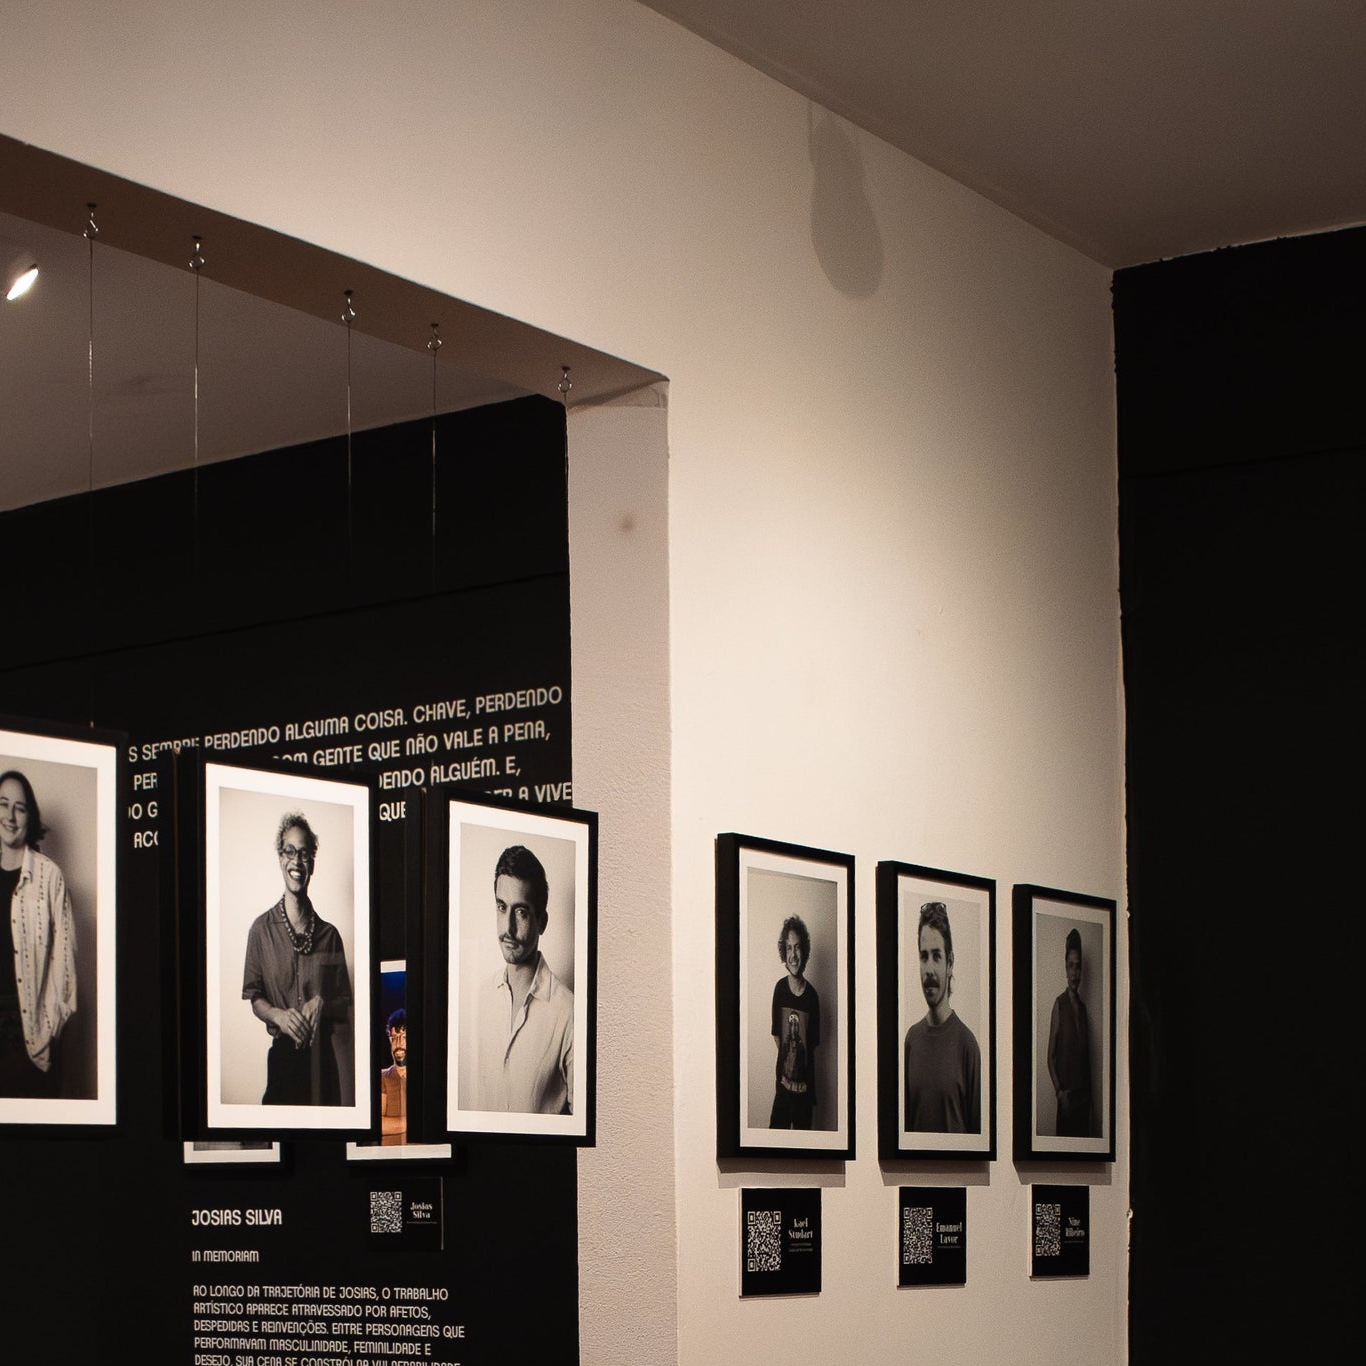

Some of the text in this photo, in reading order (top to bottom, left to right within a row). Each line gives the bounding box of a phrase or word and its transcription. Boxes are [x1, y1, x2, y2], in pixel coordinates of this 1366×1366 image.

[286, 716, 348, 741] ALGUMA
[354, 708, 407, 732] COISA.
[413, 699, 470, 723] CHAVE,
[476, 685, 562, 714] PERDENDO
[313, 744, 362, 766] GENTE
[368, 739, 400, 761] QUE
[406, 733, 438, 756] NÃO
[443, 727, 483, 750] VALE
[504, 720, 550, 742] PENA,
[431, 755, 520, 786] ALGUÉM. E,
[410, 1201, 433, 1210] Josias
[192, 1209, 282, 1226] JOSIAS SILVA
[412, 1210, 431, 1219] Silva
[192, 1250, 259, 1263] IN MEMORIAM
[193, 1285, 207, 1297] AO
[210, 1285, 244, 1297] LONGO
[247, 1286, 260, 1298] DA
[262, 1283, 320, 1298] TRAJETÓRIA
[323, 1286, 336, 1299] DE
[393, 1287, 448, 1300] TRABALHO
[194, 1301, 243, 1315] ARTÍSTICO
[246, 1302, 289, 1316] APARECE
[292, 1303, 362, 1317] ATRAVESSADO
[365, 1305, 387, 1318] POR
[194, 1319, 250, 1332] DESPEDIDAS
[332, 1322, 362, 1336] ENTRE
[366, 1323, 440, 1337] PERSONAGENS
[443, 1325, 464, 1339] QUE
[195, 1336, 266, 1350] PERFORMAVAM
[354, 1340, 421, 1355] FEMINILIDADE
